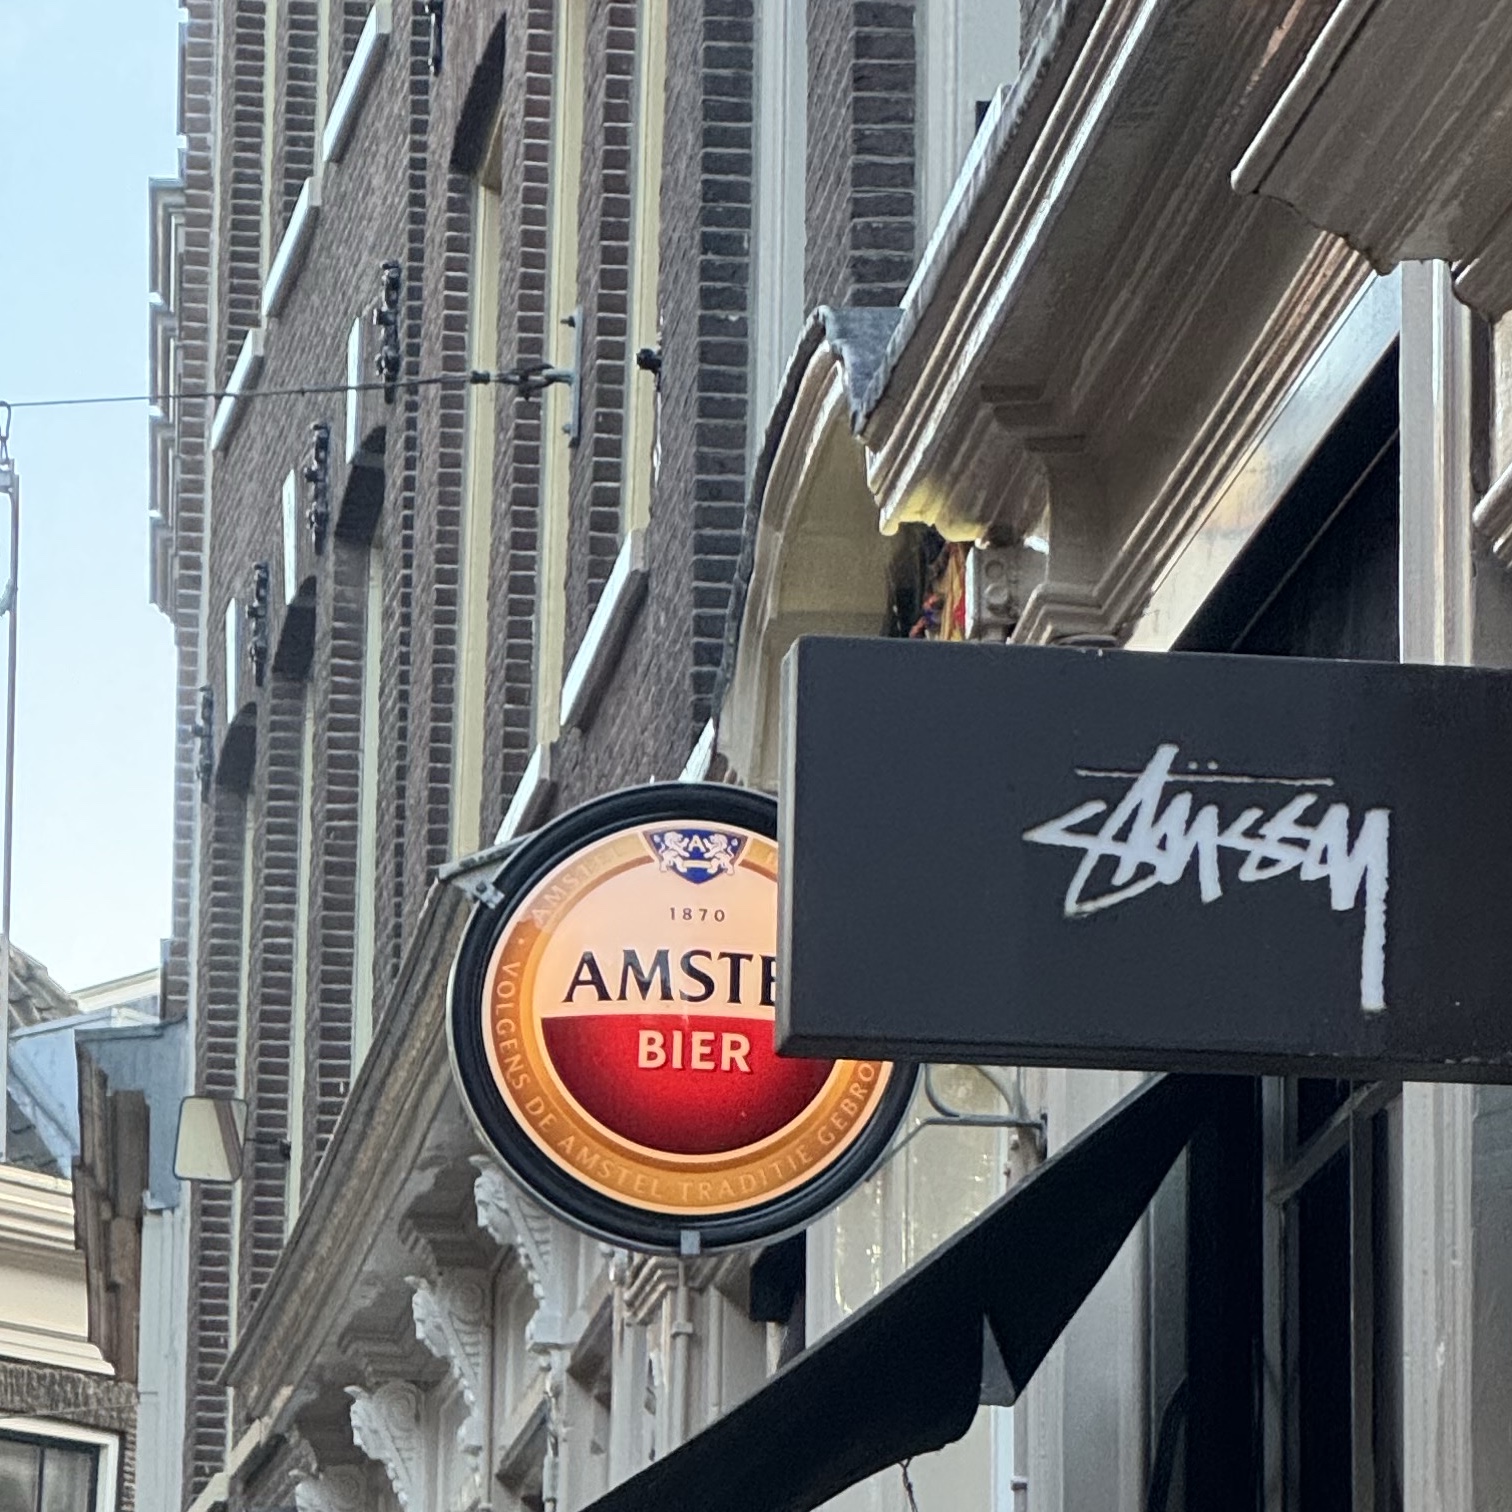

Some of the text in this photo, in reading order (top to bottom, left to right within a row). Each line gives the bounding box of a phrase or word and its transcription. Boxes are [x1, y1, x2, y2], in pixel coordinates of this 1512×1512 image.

[688, 834, 706, 853] A
[530, 845, 627, 931] AMSTEL
[669, 907, 726, 922] 1870
[637, 1029, 751, 1073] BIER
[495, 961, 532, 1091] VOLGENS
[523, 1094, 559, 1134] DE
[558, 1134, 664, 1200] AMSTEL
[676, 1148, 814, 1203] TRADITIE
